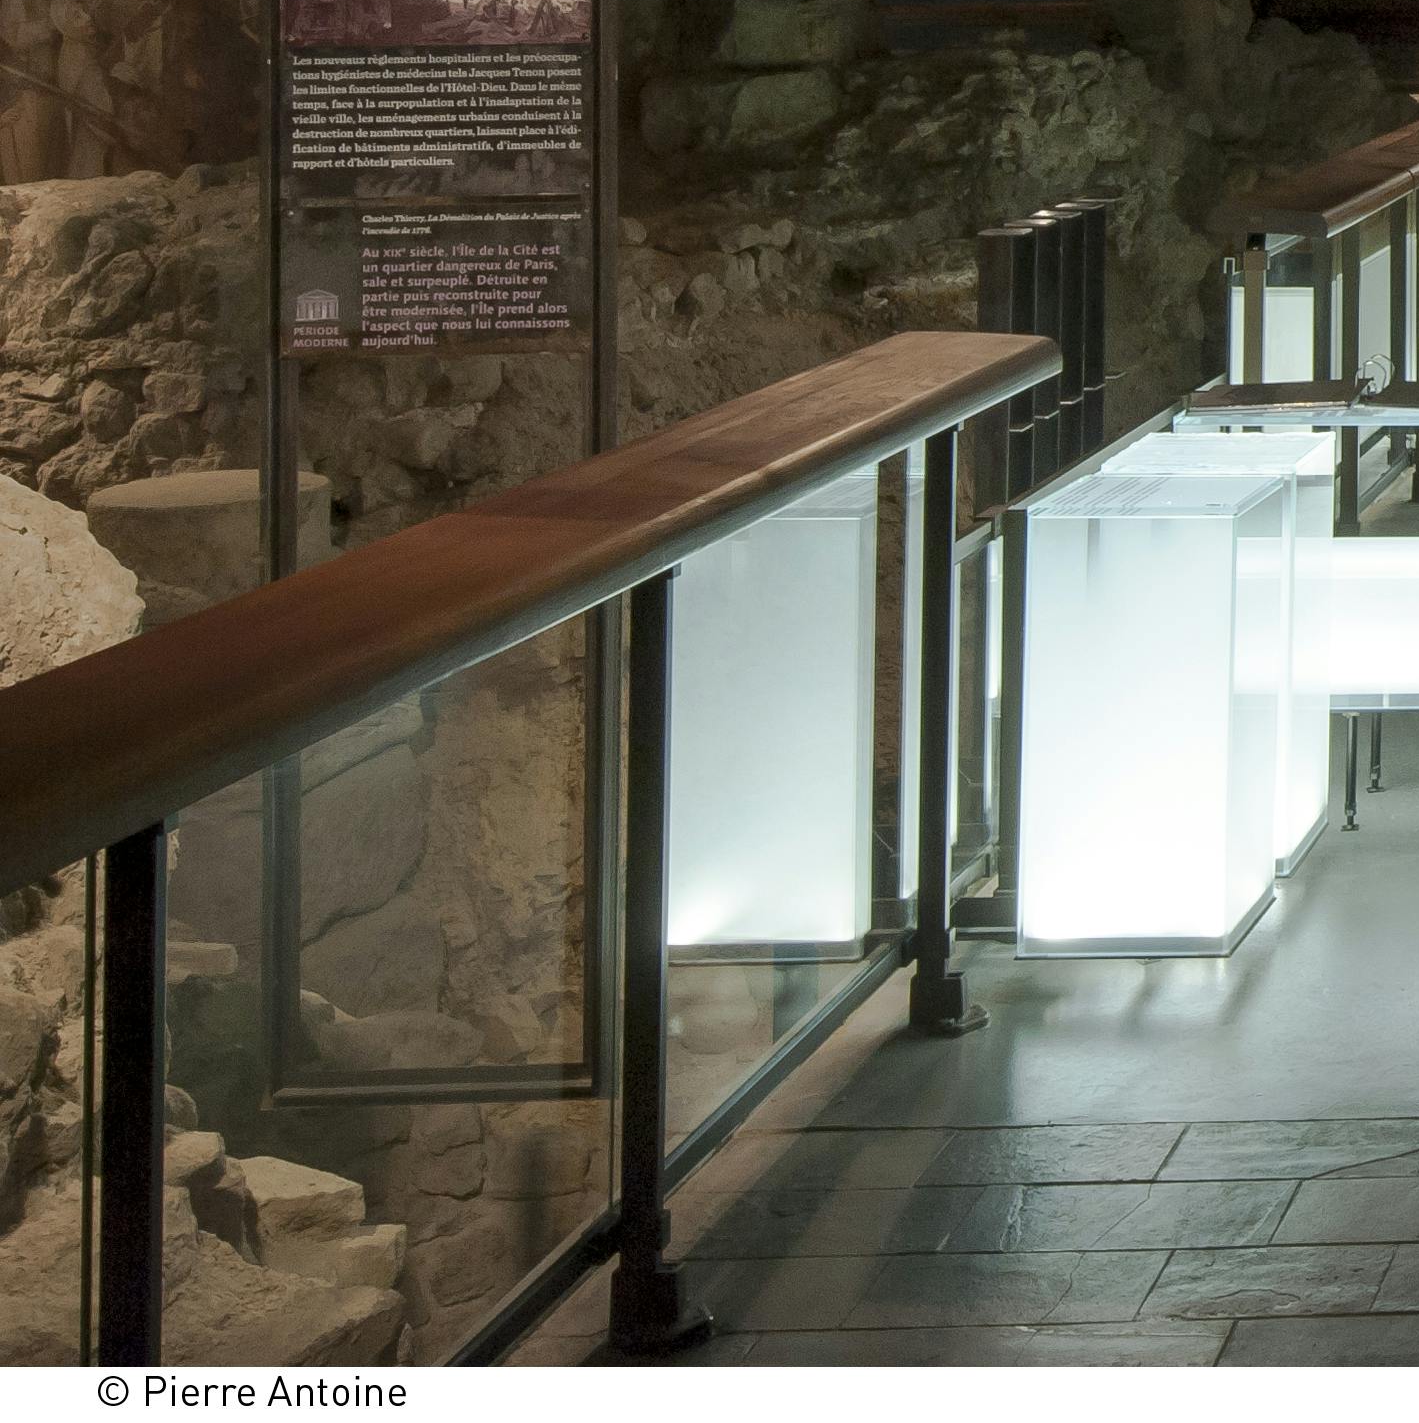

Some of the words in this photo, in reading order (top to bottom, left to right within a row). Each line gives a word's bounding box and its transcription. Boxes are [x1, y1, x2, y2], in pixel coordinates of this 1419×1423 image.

[293, 56, 311, 65] Les
[314, 57, 365, 65] nouveaux
[368, 55, 426, 66] règlements
[428, 54, 491, 64] hospitaliers
[493, 53, 503, 62] et
[506, 53, 520, 62] les
[523, 53, 581, 63] préoccupa-
[293, 71, 319, 80] tions
[322, 70, 381, 81] hygiénistes
[383, 69, 394, 78] de
[397, 69, 446, 78] médecins
[448, 68, 467, 77] tels
[469, 68, 510, 79] Jacques
[512, 67, 545, 77] Tenon
[547, 68, 581, 78] posent
[293, 85, 308, 95] les
[310, 85, 346, 94] limites
[349, 84, 424, 94] fonctionnelles
[426, 83, 438, 93] de
[510, 82, 536, 91] Dans
[538, 82, 548, 91] le
[550, 81, 581, 91] même
[293, 101, 328, 110] temps,
[332, 99, 354, 109] face
[357, 99, 363, 108] à
[366, 99, 375, 108] la
[378, 98, 454, 109] surpopulation
[457, 98, 468, 107] et
[471, 97, 476, 106] à
[479, 96, 554, 108] l'inadaptation
[557, 96, 569, 105] de
[572, 96, 581, 105] la
[292, 114, 326, 123] vieille
[329, 114, 356, 124] ville,
[358, 113, 373, 123] les
[376, 113, 456, 124] aménagements
[459, 112, 499, 121] urbains
[502, 111, 560, 121] conduisent
[563, 111, 569, 120] à
[572, 110, 581, 119] la
[292, 129, 354, 138] destruction
[356, 128, 368, 137] de
[370, 128, 423, 137] nombreux
[425, 126, 475, 138] quartiers,
[477, 126, 516, 136] laissant
[519, 125, 546, 137] place
[548, 125, 554, 135] à
[556, 125, 581, 135] l'édi-
[292, 143, 336, 153] fication
[338, 143, 351, 153] de
[354, 143, 410, 152] bâtiments
[413, 141, 494, 151] administratifs,
[497, 140, 566, 151] d'immeubles
[569, 140, 581, 149] de
[293, 159, 332, 169] rapport
[335, 159, 345, 168] et
[348, 157, 389, 167] d'hôtels
[391, 156, 454, 168] particuliers.
[362, 247, 379, 258] Au
[409, 246, 448, 257] siècle,
[479, 245, 494, 256] de
[498, 245, 509, 256] la
[513, 244, 538, 256] Cité
[542, 245, 560, 255] est
[362, 263, 378, 273] un
[382, 261, 432, 275] quartier
[436, 260, 501, 273] dangereux
[505, 259, 520, 270] de
[524, 259, 558, 271] Paris,
[362, 276, 386, 287] sale
[391, 277, 404, 287] et
[408, 275, 473, 289] surpeuplé.
[477, 274, 529, 285] Détruite
[532, 276, 548, 285] en
[362, 291, 399, 305] partie
[404, 290, 429, 303] puis
[433, 289, 509, 301] reconstruite
[512, 290, 541, 302] pour
[362, 305, 387, 317] être
[391, 304, 466, 317] modernisée,
[498, 303, 534, 317] prend
[538, 303, 568, 314] alors
[362, 320, 410, 335] l'aspect
[415, 320, 438, 333] que
[442, 320, 471, 330] nous
[476, 318, 491, 329] lui
[495, 317, 570, 329] connaissons
[293, 337, 348, 347] MODERNE
[362, 335, 437, 349] aujourd'hui.
